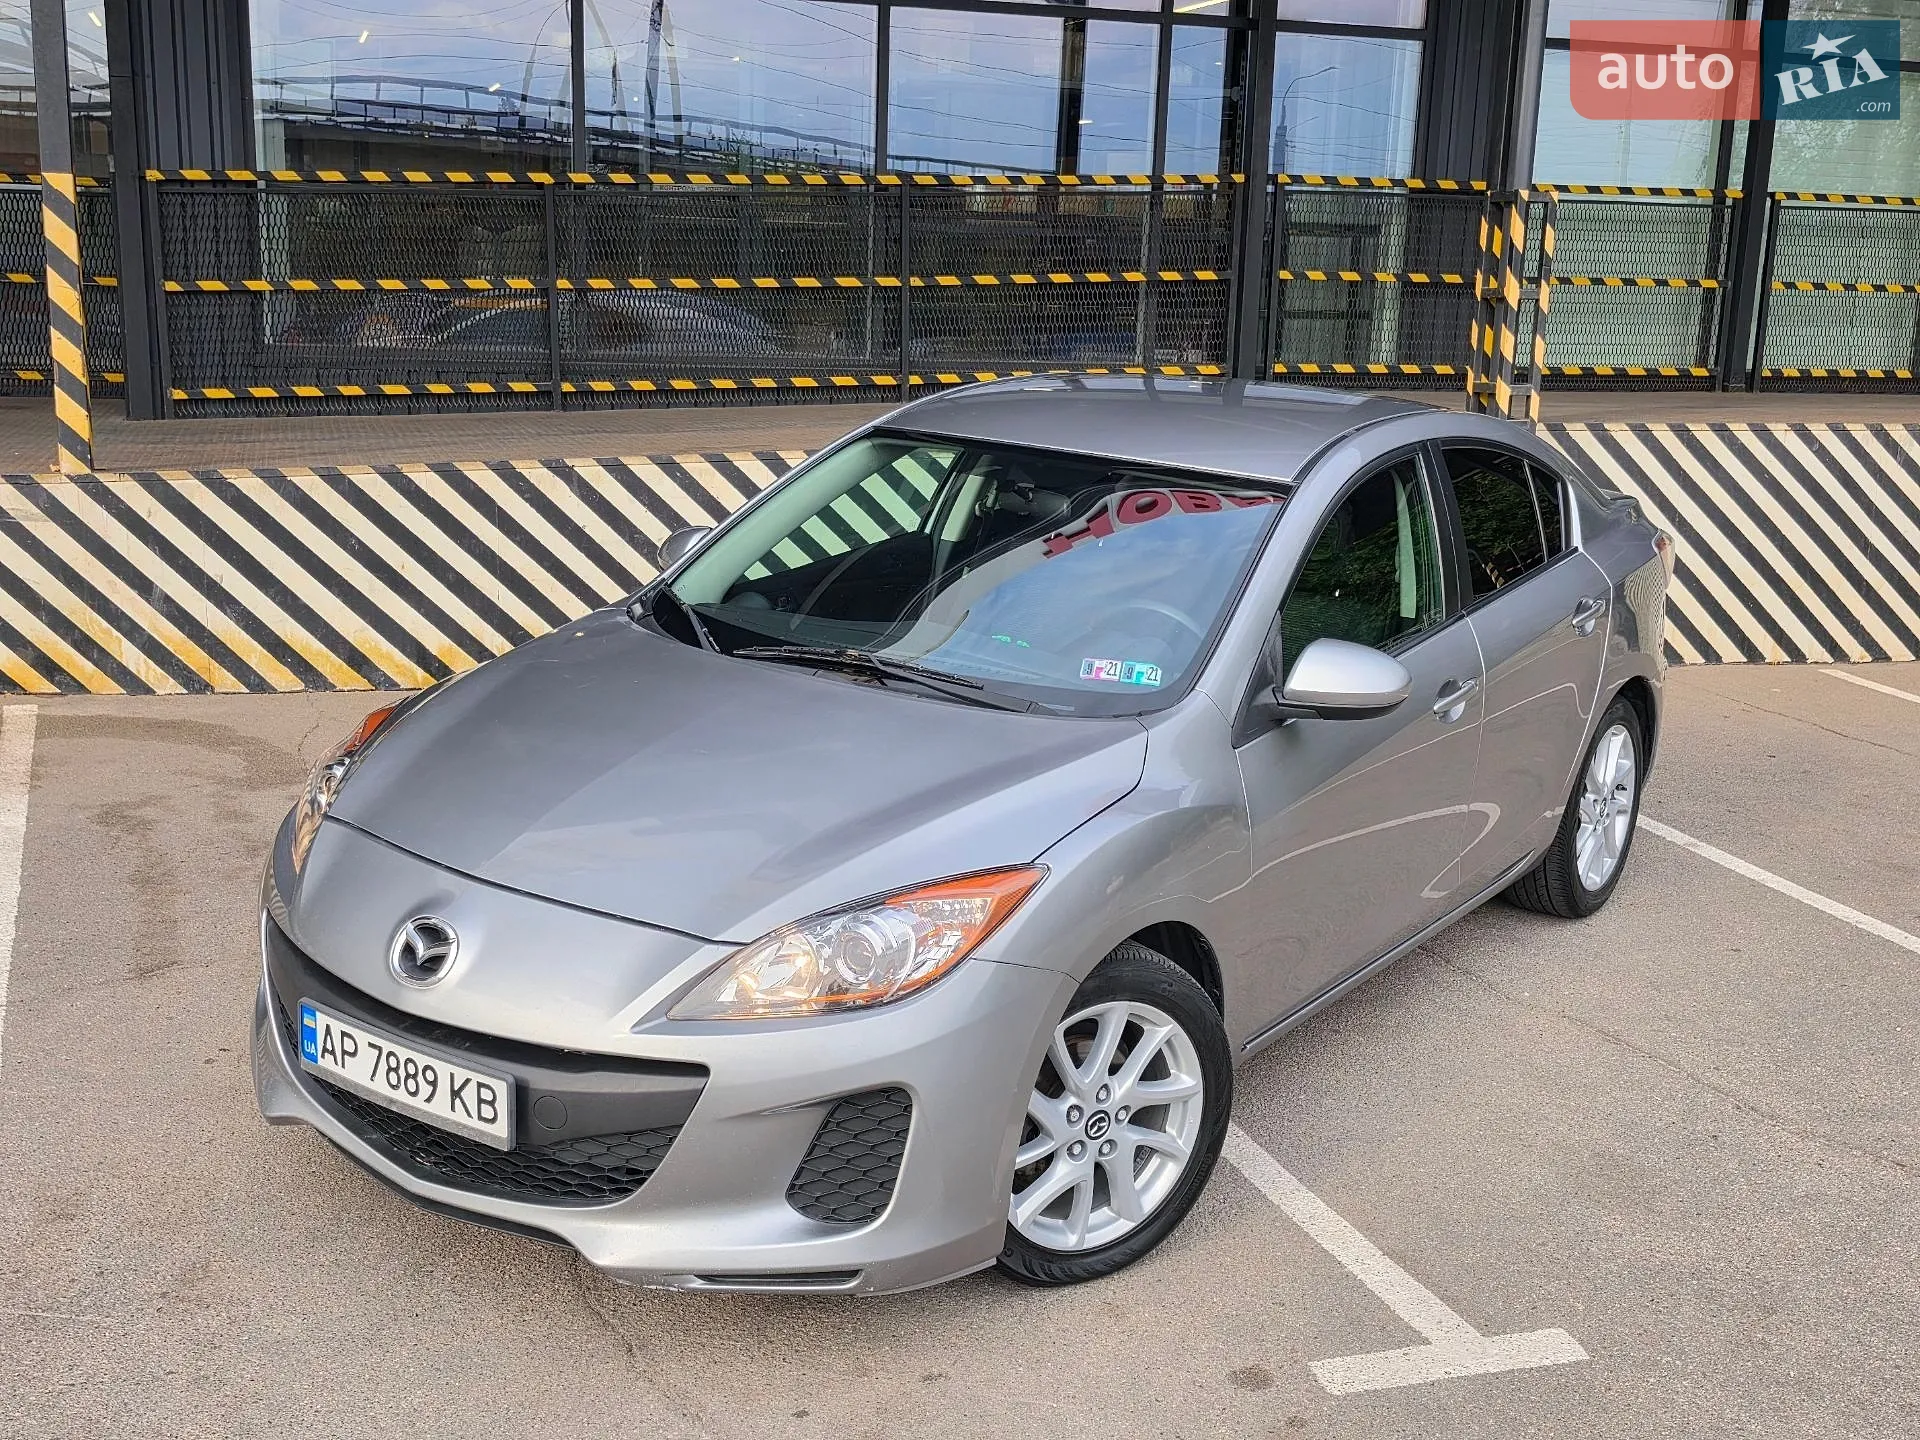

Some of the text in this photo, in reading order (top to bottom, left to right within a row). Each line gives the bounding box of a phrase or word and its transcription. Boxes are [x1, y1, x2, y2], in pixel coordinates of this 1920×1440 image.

[304, 1039, 317, 1056] UA
[320, 1023, 499, 1125] AP 7889 KB
